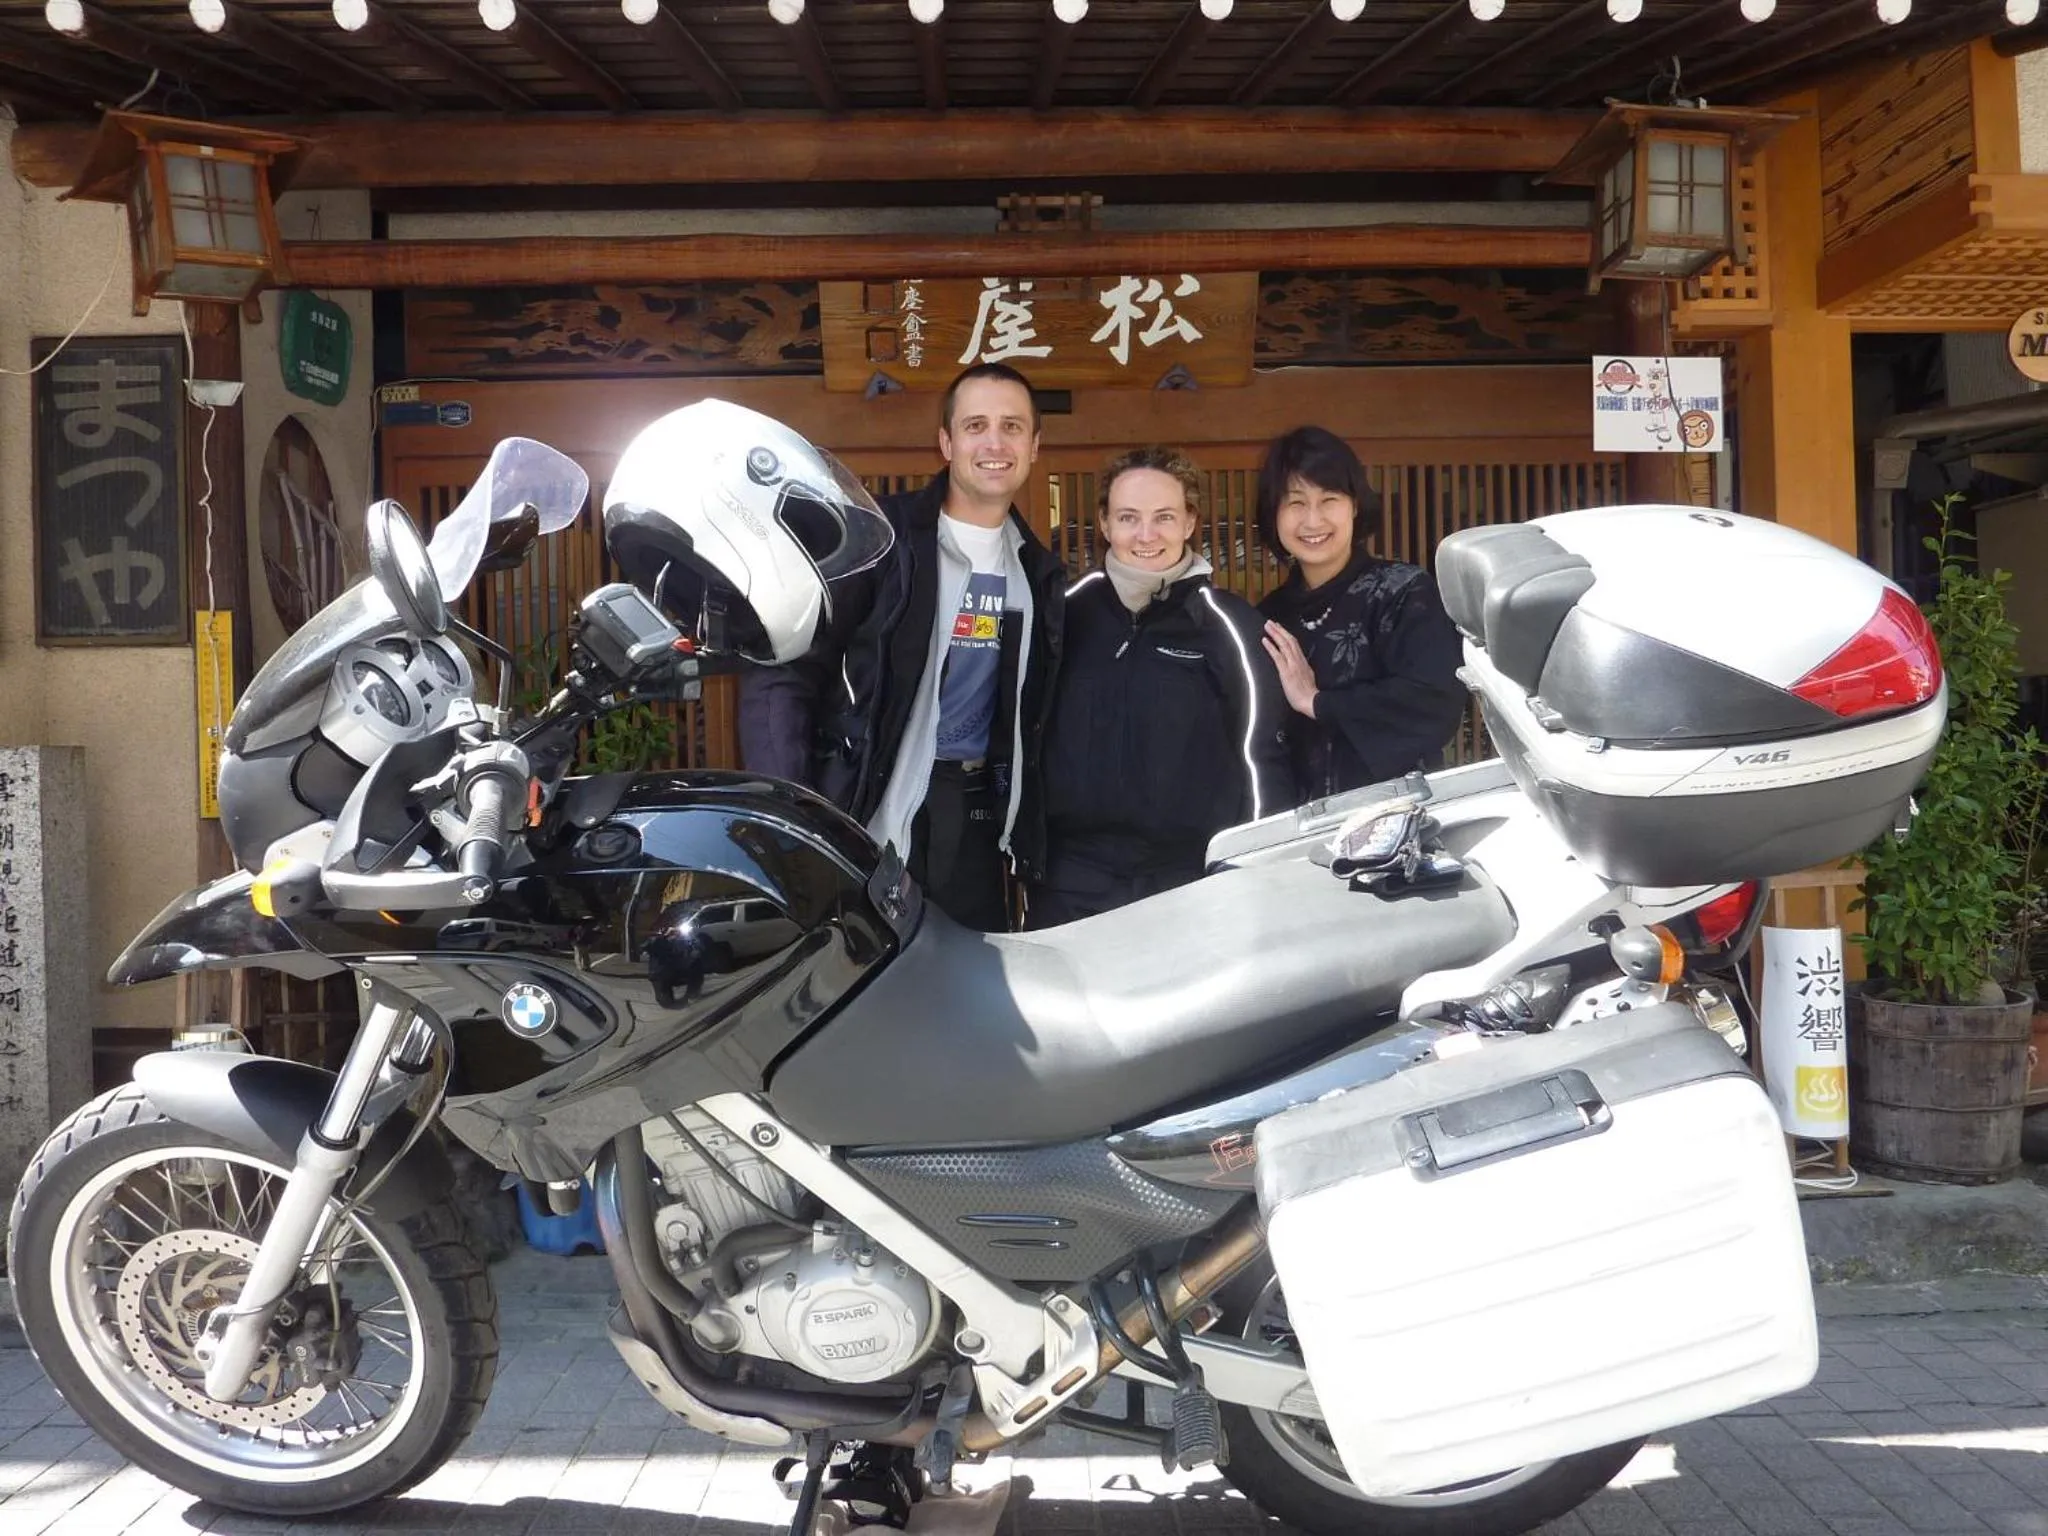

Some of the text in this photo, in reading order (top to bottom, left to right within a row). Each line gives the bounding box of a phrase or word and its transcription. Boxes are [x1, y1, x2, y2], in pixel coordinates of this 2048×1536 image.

[957, 274, 1203, 365] 松屋
[2034, 312, 2048, 326] S
[51, 358, 166, 625] まつや
[1733, 749, 1792, 766] V46
[507, 986, 552, 1005] BMW
[1796, 945, 1844, 1052] 渋響
[820, 1336, 877, 1360] BMW
